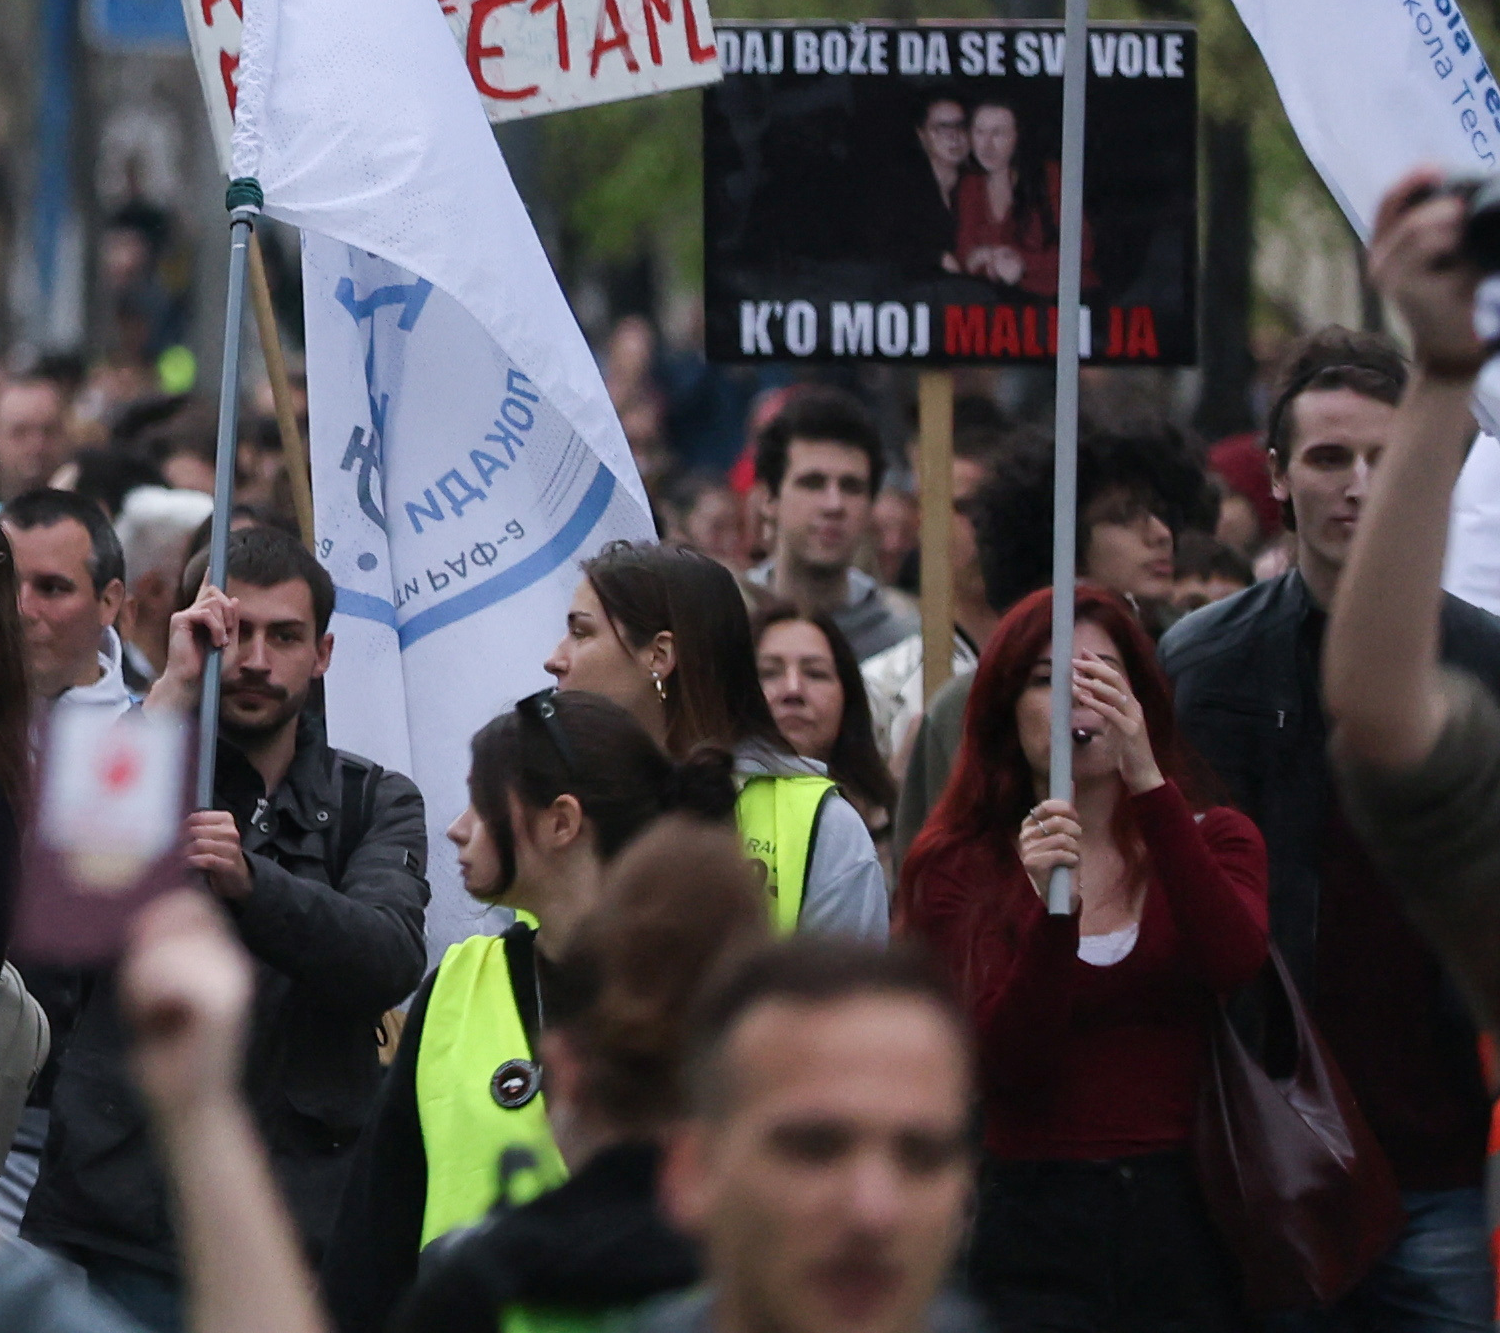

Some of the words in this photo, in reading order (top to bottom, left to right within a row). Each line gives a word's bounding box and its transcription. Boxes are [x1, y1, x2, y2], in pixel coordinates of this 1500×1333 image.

[716, 28, 785, 76] DAJ
[793, 20, 890, 77] BOŽE
[898, 31, 953, 77] DA
[959, 32, 1008, 78] SE
[1015, 33, 1065, 79] SV
[1090, 33, 1186, 79] VOLE
[830, 302, 932, 359] MOJ
[1105, 304, 1161, 360] JA
